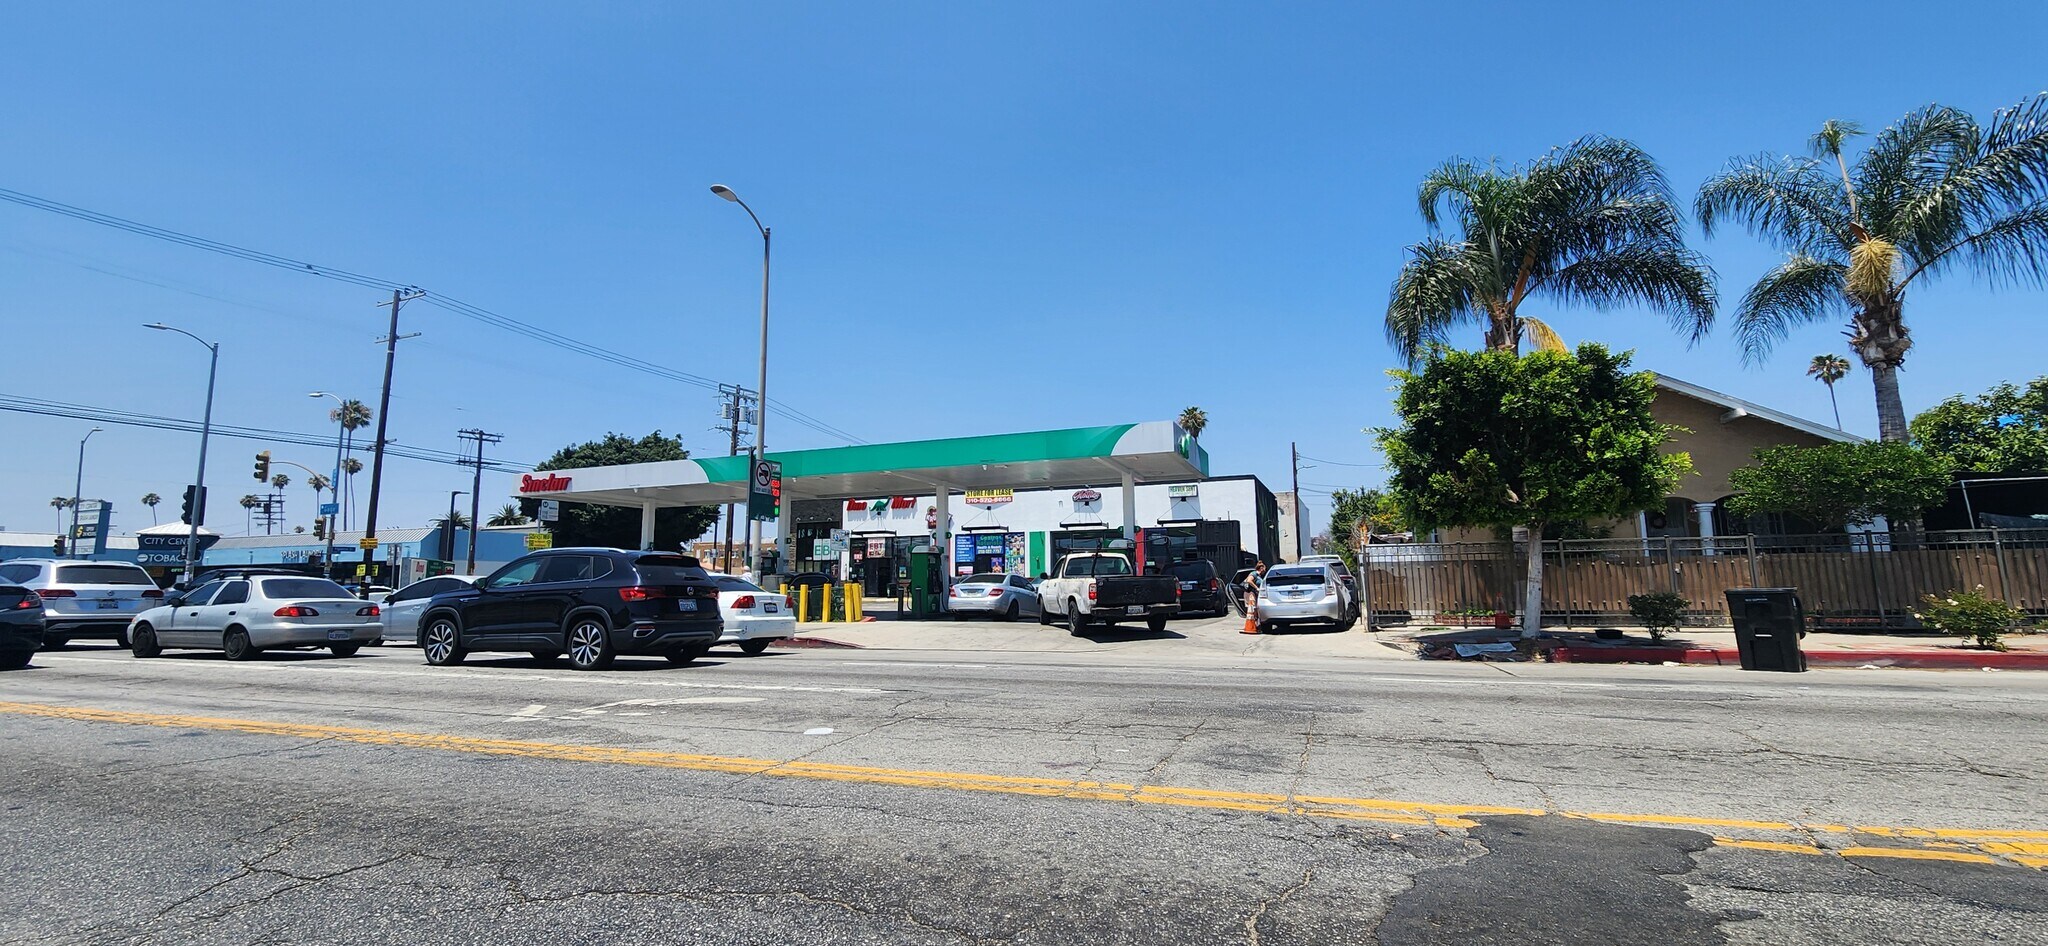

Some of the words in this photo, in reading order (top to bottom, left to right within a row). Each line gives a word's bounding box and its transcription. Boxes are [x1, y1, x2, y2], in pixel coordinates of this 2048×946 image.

[520, 473, 572, 492] Sinclair
[847, 499, 867, 511] Dino
[891, 497, 917, 509] Mart
[144, 537, 165, 545] CITY
[168, 537, 200, 545] CEN
[149, 554, 202, 562] TOBAC
